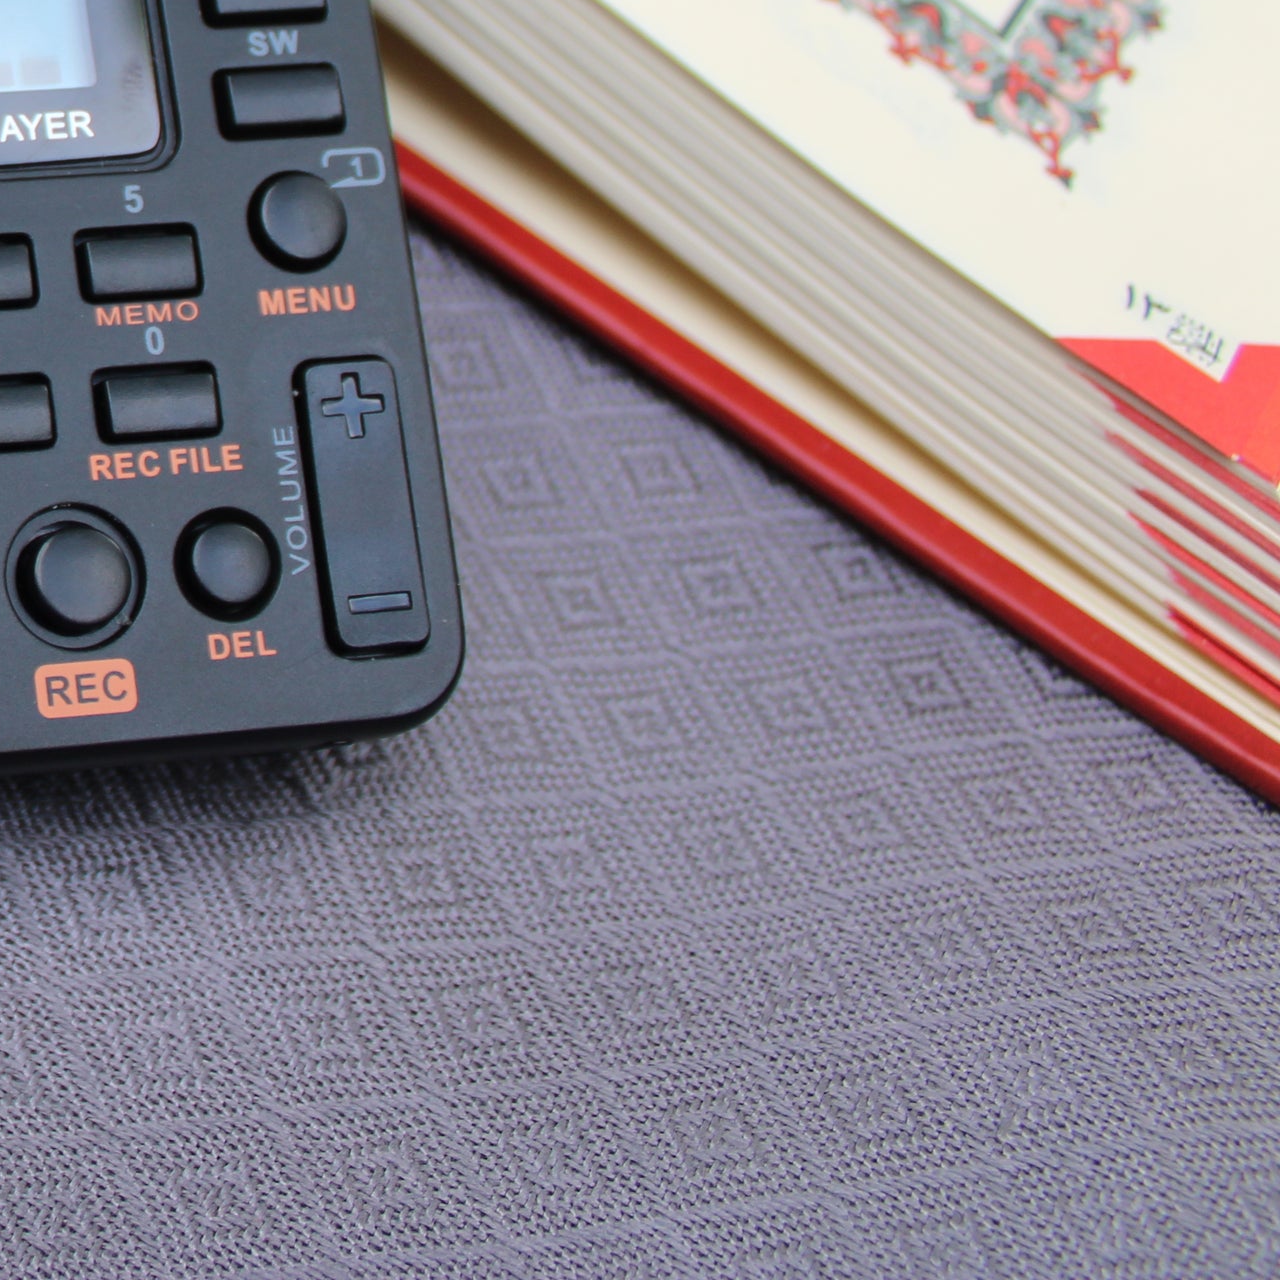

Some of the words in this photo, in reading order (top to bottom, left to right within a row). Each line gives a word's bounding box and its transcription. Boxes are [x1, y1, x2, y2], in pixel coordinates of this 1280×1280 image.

[248, 31, 300, 56] SW
[124, 185, 144, 213] 5
[95, 301, 199, 327] MEMO
[258, 285, 357, 316] MENU
[145, 326, 165, 356] 0
[89, 451, 161, 481] REC
[170, 445, 243, 474] FILE
[273, 425, 312, 575] VOLUME
[208, 631, 278, 661] DEL
[45, 671, 128, 707] REC
